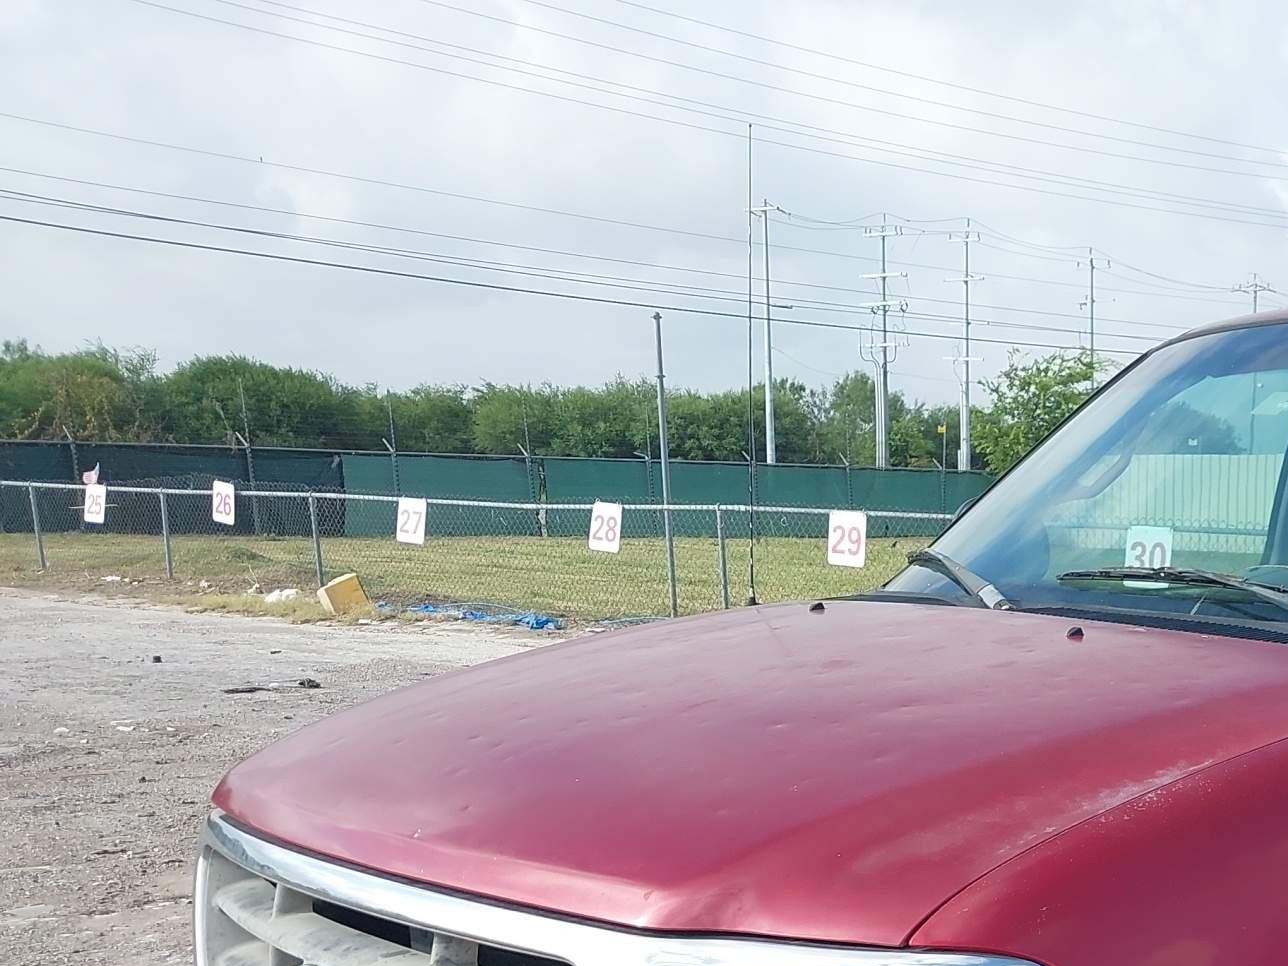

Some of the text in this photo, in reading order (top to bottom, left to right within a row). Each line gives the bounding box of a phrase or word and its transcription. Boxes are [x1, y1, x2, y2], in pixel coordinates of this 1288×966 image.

[87, 494, 102, 515] 25
[215, 491, 232, 516] 26
[400, 509, 423, 535] 27
[592, 515, 617, 543] 28
[831, 525, 862, 557] 29
[1130, 541, 1167, 568] 30
